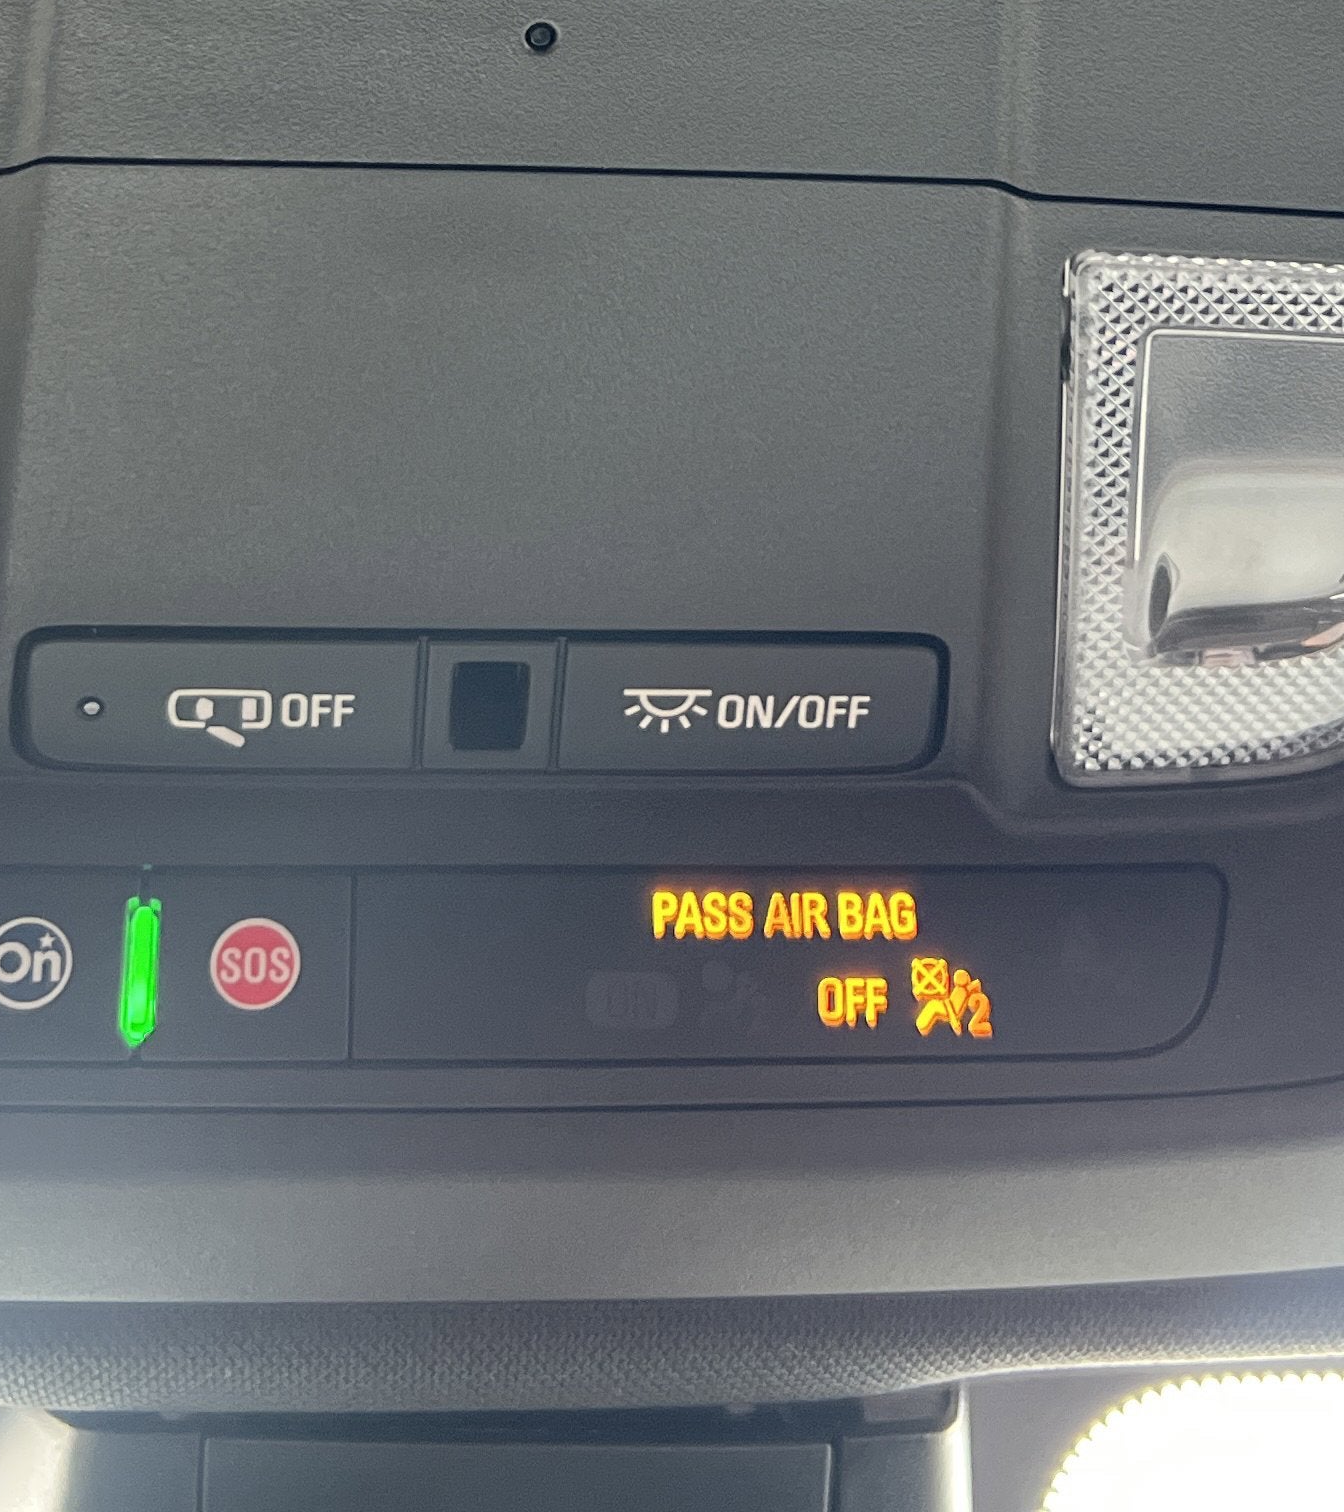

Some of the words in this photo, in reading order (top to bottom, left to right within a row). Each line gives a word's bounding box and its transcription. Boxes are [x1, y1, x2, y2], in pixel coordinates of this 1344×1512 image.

[279, 692, 357, 729] OFF
[716, 693, 872, 730] ON/OFF
[651, 889, 755, 940] PASS
[763, 891, 832, 940] AIR
[837, 891, 918, 940] BAG
[218, 945, 292, 985] SOS
[817, 976, 888, 1028] OFF
